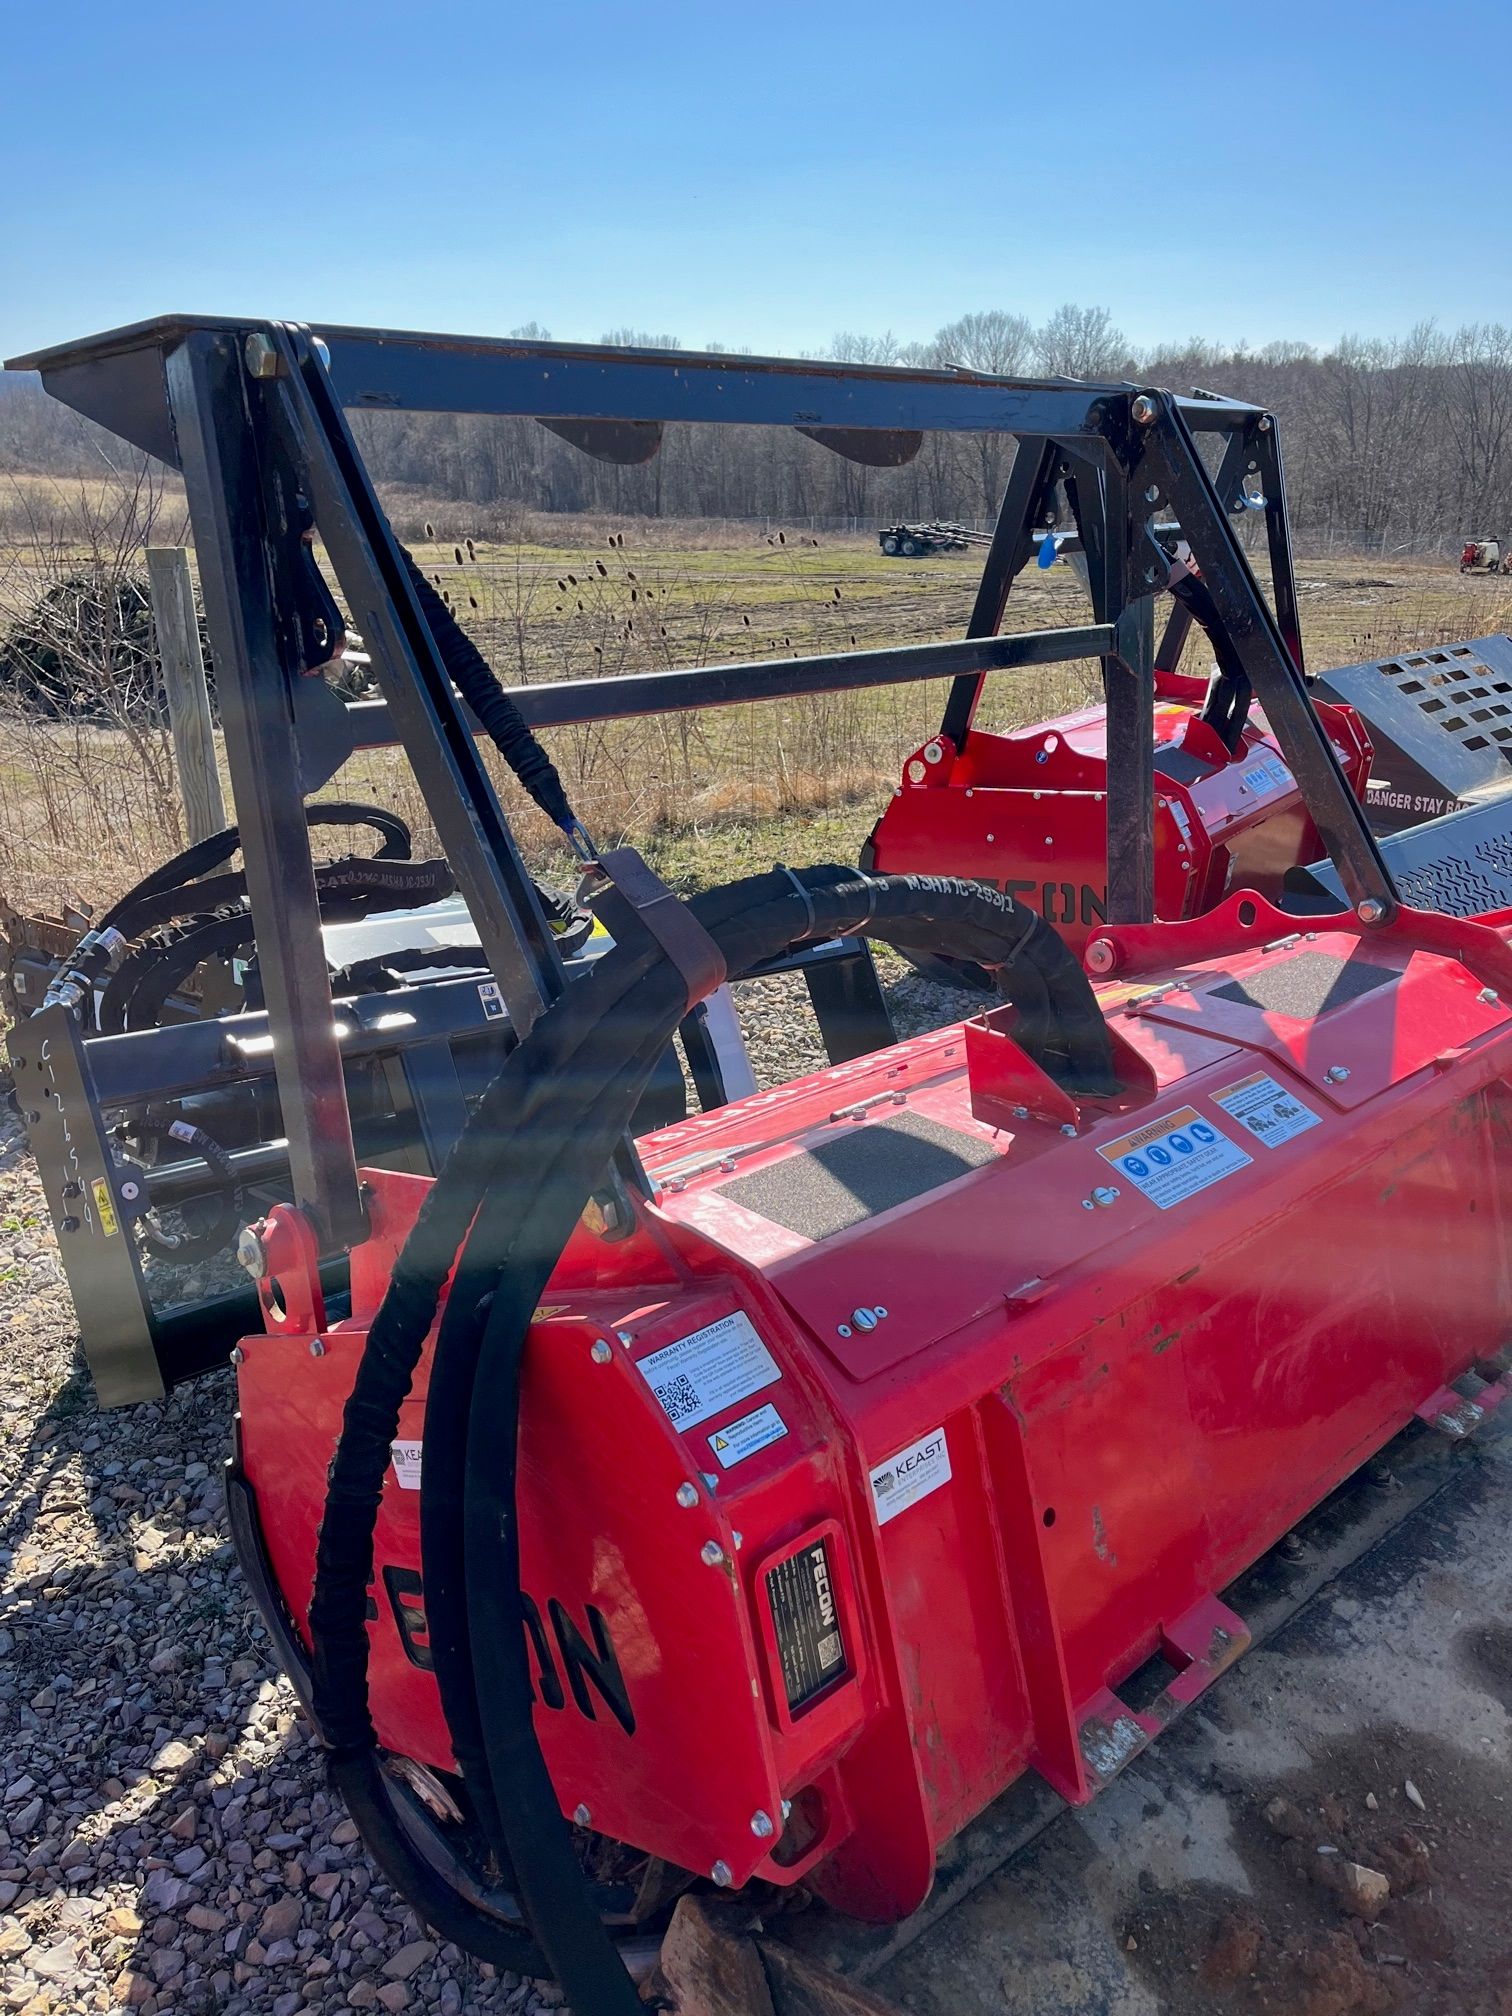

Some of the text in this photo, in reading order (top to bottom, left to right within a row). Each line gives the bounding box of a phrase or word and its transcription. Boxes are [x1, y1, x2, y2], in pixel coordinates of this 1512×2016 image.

[1367, 790, 1412, 810] DANGER
[1414, 796, 1444, 814] STAY
[1136, 1119, 1176, 1144] WARNING
[647, 1340, 687, 1366] WARRANTY
[687, 1318, 735, 1347] REGISTRATION
[896, 1438, 943, 1478] KEAST
[810, 1546, 835, 1628] FECON
